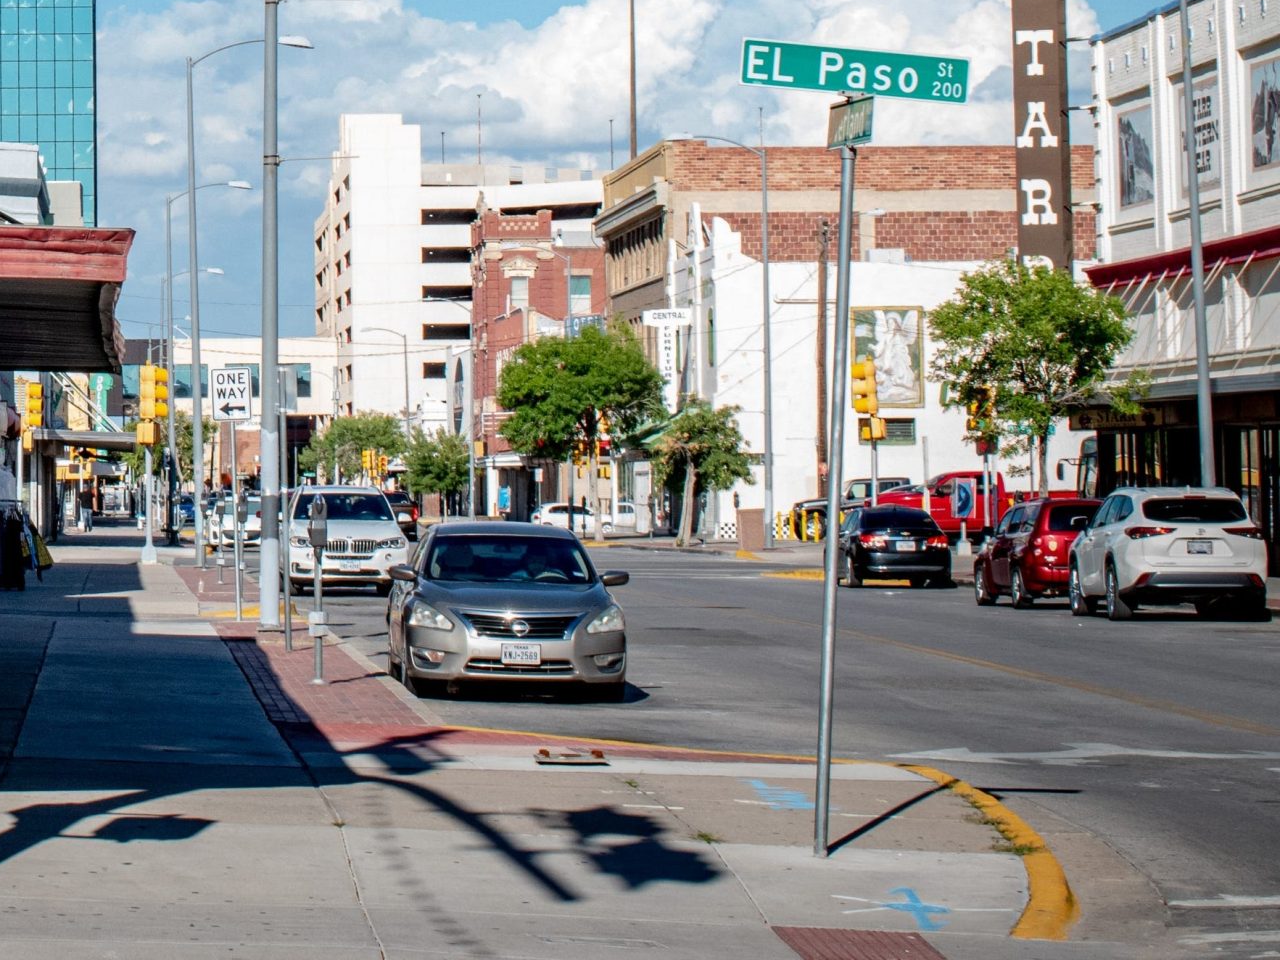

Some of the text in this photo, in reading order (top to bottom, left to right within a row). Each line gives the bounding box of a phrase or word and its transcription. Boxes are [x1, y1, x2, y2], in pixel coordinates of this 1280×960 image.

[818, 51, 919, 94] Paso
[936, 62, 954, 79] St
[931, 81, 962, 99] 200
[651, 311, 687, 321] CENTRAL
[216, 372, 246, 385] ONE
[216, 387, 246, 399] WAY
